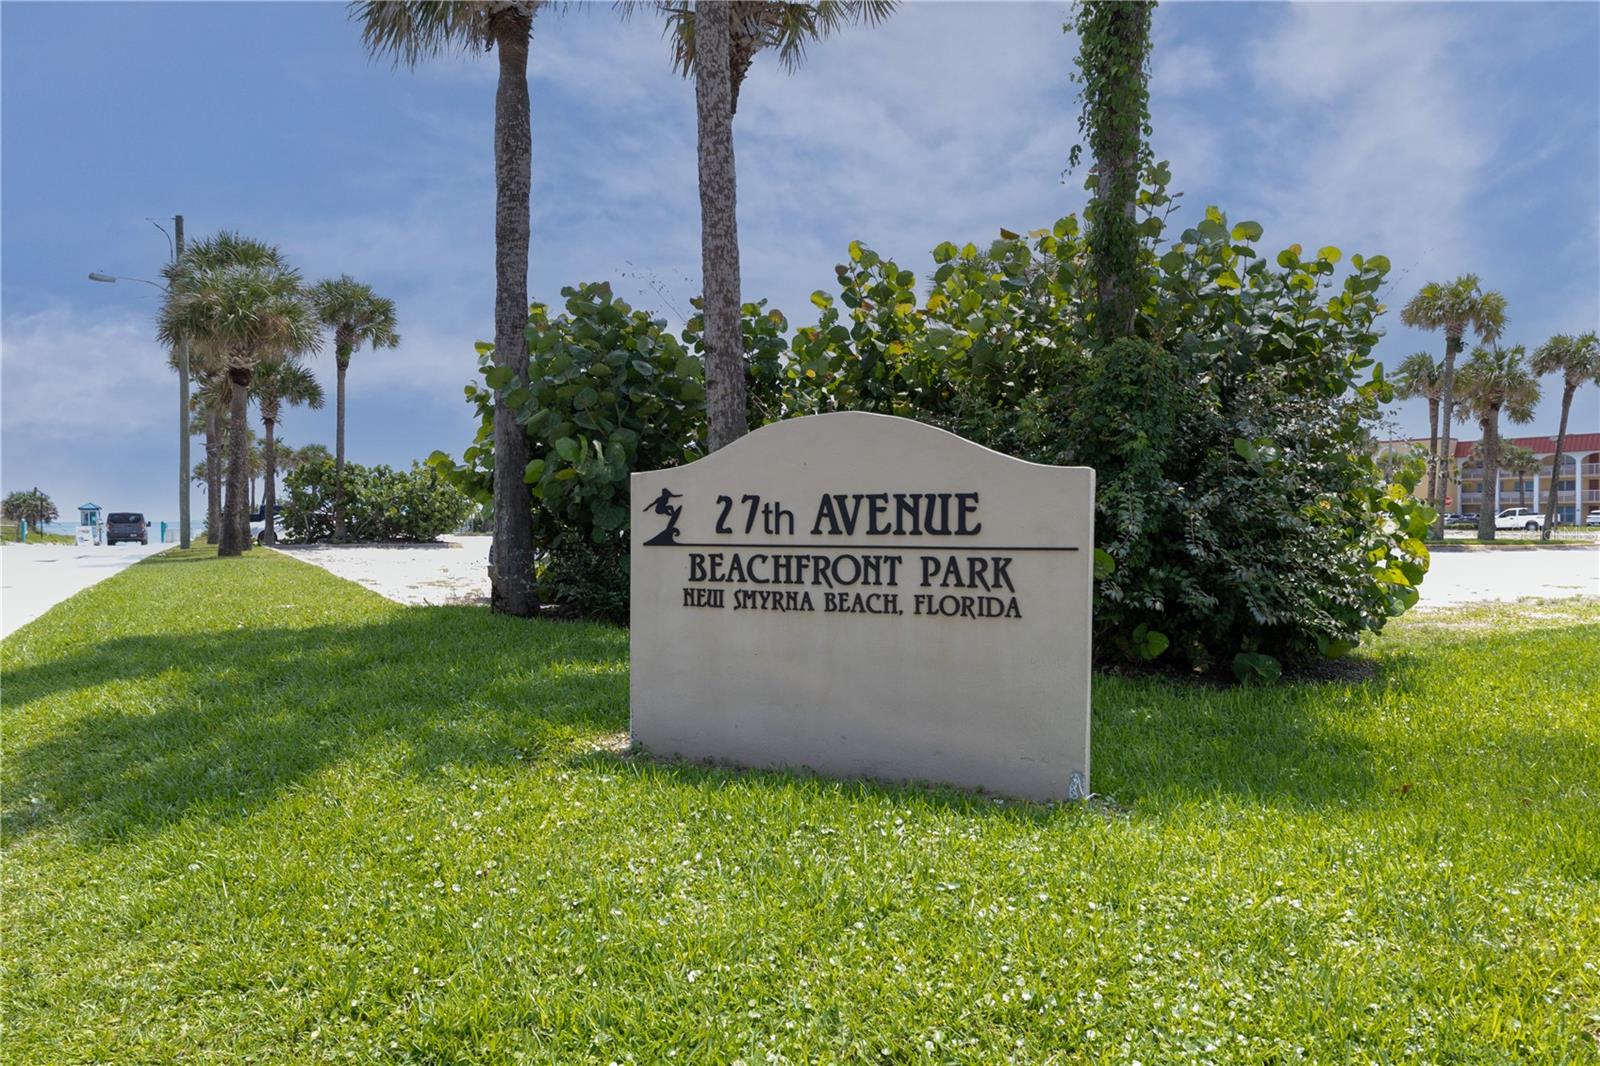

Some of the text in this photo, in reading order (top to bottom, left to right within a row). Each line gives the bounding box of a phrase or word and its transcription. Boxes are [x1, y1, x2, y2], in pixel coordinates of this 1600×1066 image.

[715, 491, 983, 537] 27th AVENUE
[687, 552, 1016, 593] BEACHFRONT PARK
[682, 587, 725, 609] NEW
[733, 588, 816, 614] SMYRNA
[912, 593, 1023, 620] FLORIDA
